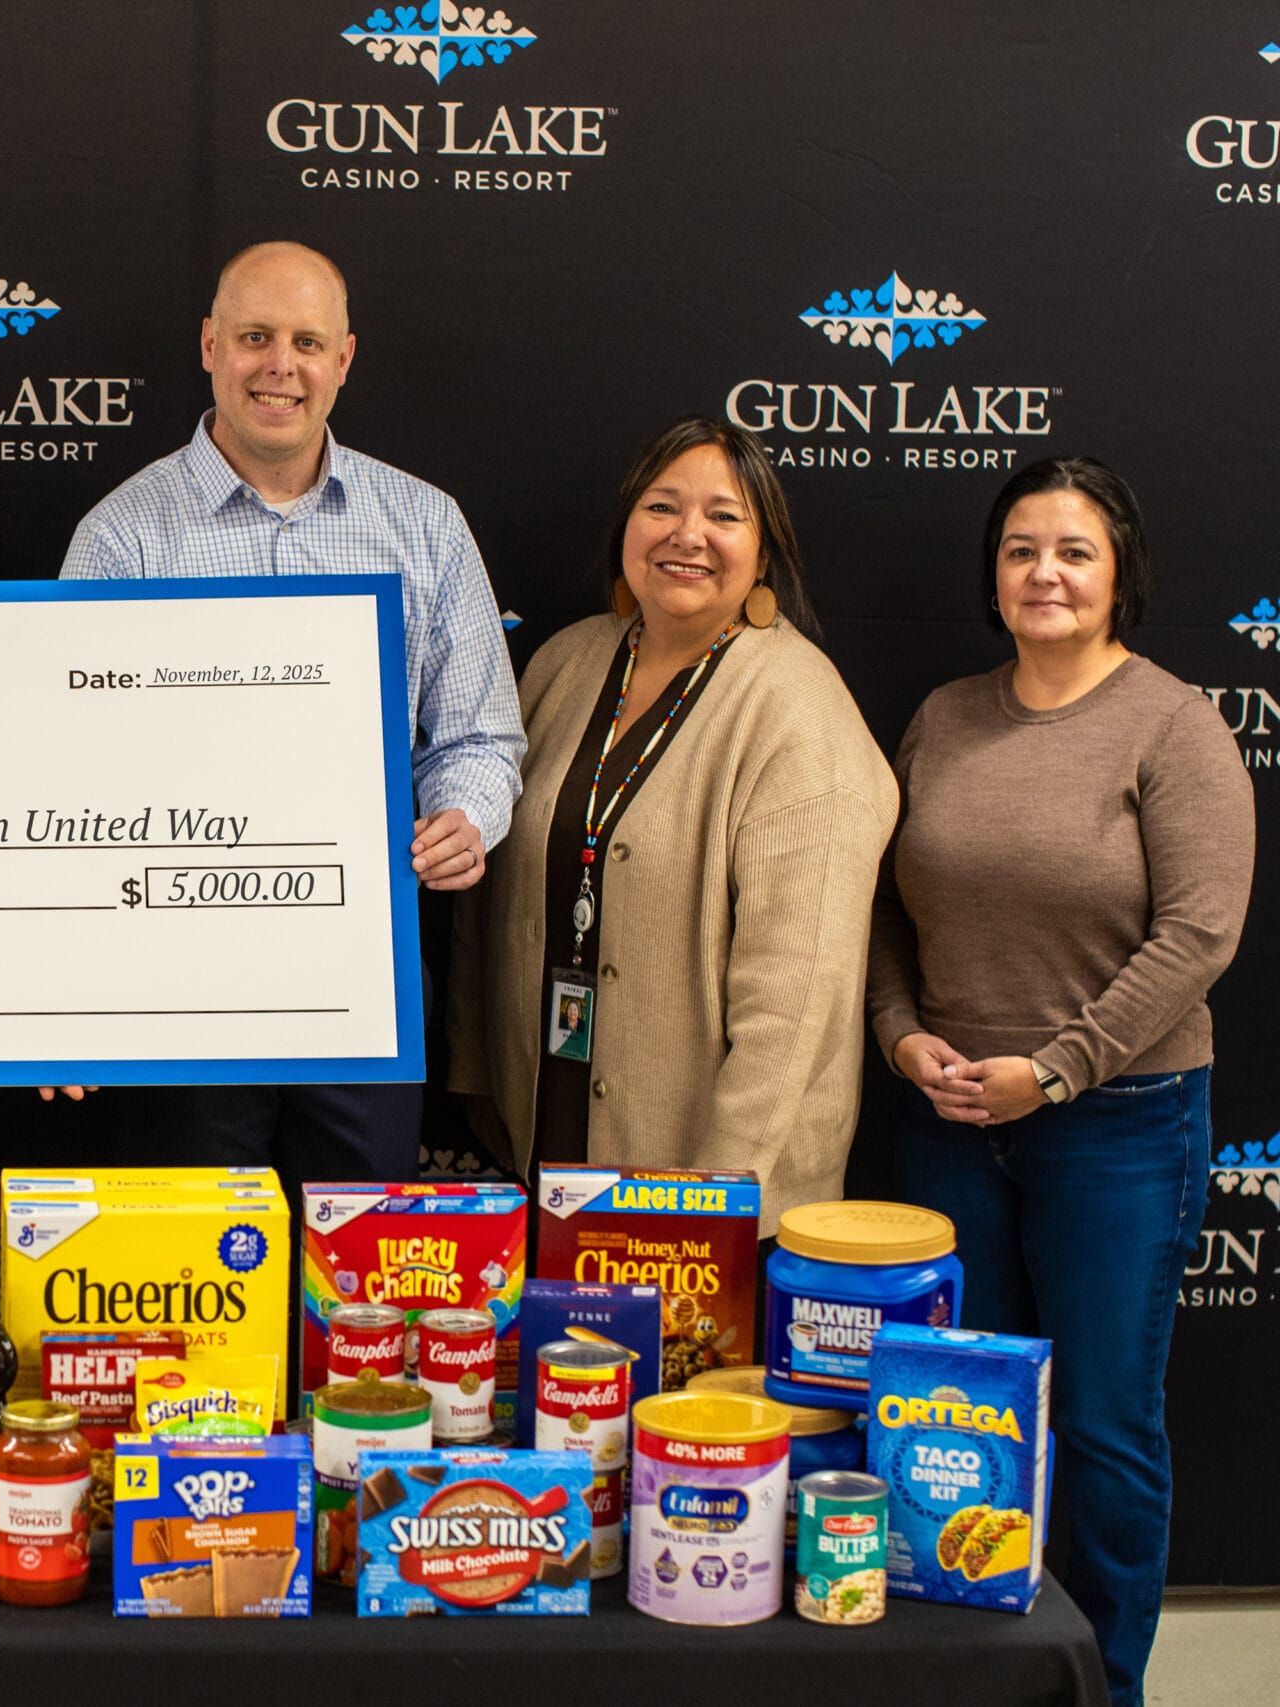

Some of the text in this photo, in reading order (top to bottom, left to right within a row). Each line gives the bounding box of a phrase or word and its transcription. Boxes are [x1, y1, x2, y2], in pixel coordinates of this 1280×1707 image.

[266, 98, 607, 156] GUN LAKE
[301, 168, 572, 191] CASINO RESORT
[726, 379, 1052, 435] GUN LAKE
[904, 448, 1018, 469] RESORT
[69, 664, 324, 690] Date: November, 12, 2025
[24, 807, 153, 842] United
[166, 807, 249, 849] Way
[121, 877, 143, 909] $
[167, 871, 315, 907] 5,000.00
[612, 1185, 728, 1212] LARGE SIZE
[229, 1231, 259, 1253] 2g
[626, 1238, 679, 1261] Honey
[681, 1240, 712, 1259] Nut
[229, 1251, 258, 1262] SUGAR
[377, 1236, 459, 1275] Lucky
[574, 1249, 720, 1296] Cheerios
[43, 1266, 247, 1325] Cheerios
[364, 1268, 464, 1305] Charms
[1176, 1286, 1258, 1307] ASINO
[568, 1311, 612, 1323] PENNE
[792, 1296, 882, 1330] MAXWELL
[184, 1331, 228, 1347] OATS
[819, 1324, 874, 1351] HOUS
[89, 1391, 134, 1406] Pasta
[543, 1379, 619, 1410] Campbell's
[146, 1390, 238, 1427] Bisquick
[877, 1394, 1024, 1443] ORTEGA
[355, 1436, 387, 1448] meijer
[665, 1440, 747, 1462] 40% MORE
[913, 1445, 982, 1472] TACO
[124, 1468, 148, 1488] 12
[910, 1465, 981, 1489] DINNER
[669, 1491, 740, 1516] Enfamil
[929, 1484, 961, 1502] KIT
[8, 1506, 62, 1518] TRADITIONAL
[189, 1496, 246, 1520] tarts
[8, 1514, 63, 1528] TOMATO
[7, 1535, 54, 1547] PASTA SAUCE
[184, 1526, 257, 1540] BROWN SUGAR
[194, 1536, 250, 1548] CINNAMON
[387, 1515, 568, 1554] SWISS MISS
[818, 1534, 879, 1554] BUTTER
[421, 1548, 530, 1576] Milk Chocolate
[833, 1553, 867, 1564] BEANS
[368, 1598, 380, 1613] 8
